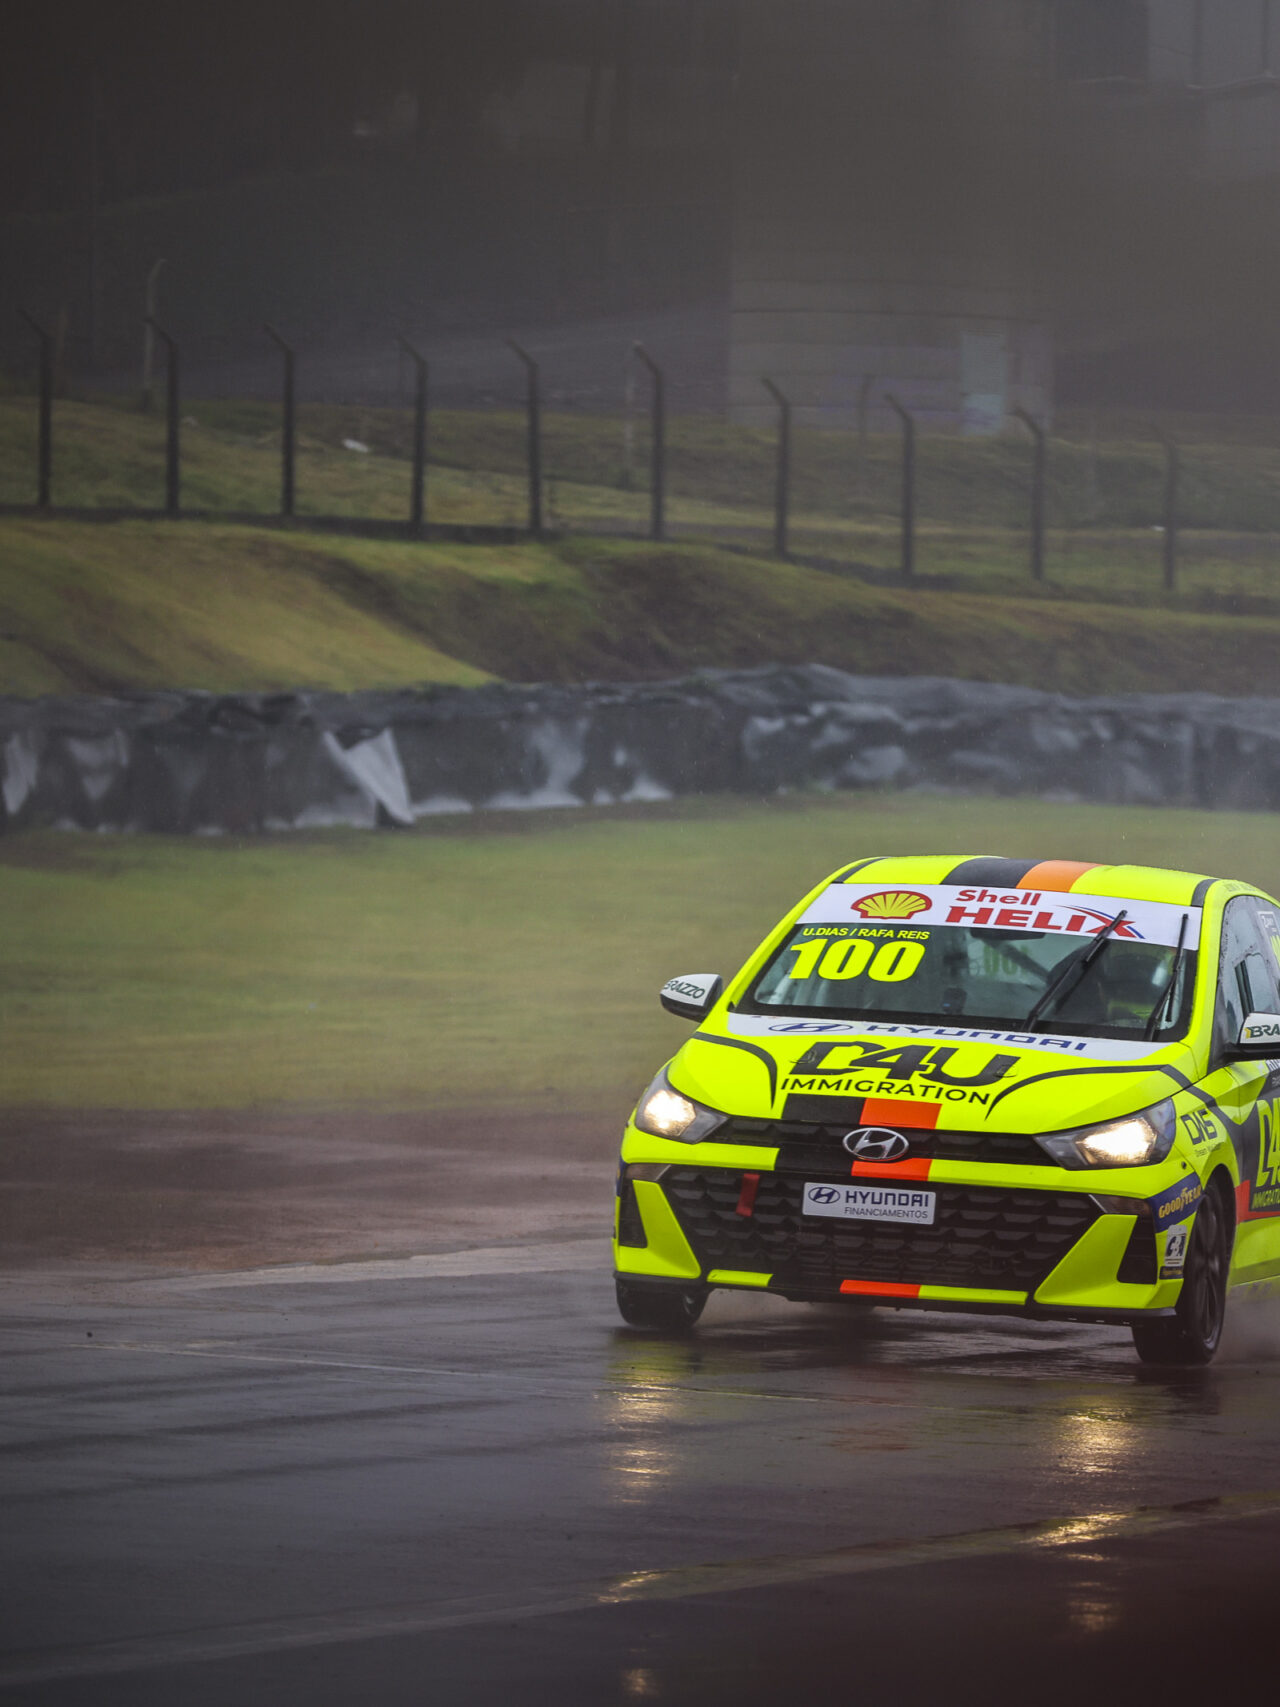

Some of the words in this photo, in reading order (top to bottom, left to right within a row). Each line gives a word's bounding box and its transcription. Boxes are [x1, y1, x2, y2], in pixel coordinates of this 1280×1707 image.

[955, 889, 1042, 906] Shell
[802, 927, 849, 937] U.DIAS
[857, 928, 894, 938] RAFA
[896, 930, 930, 940] REIS
[945, 904, 1142, 939] HELIX
[788, 938, 926, 982] 100
[865, 1024, 1088, 1051] HYUNDAI
[788, 1040, 1022, 1087] D4U
[780, 1077, 991, 1106] IMMIGRATION
[845, 1190, 929, 1207] HYUNDAI
[844, 1206, 929, 1219] FINANCIAMENTOS
